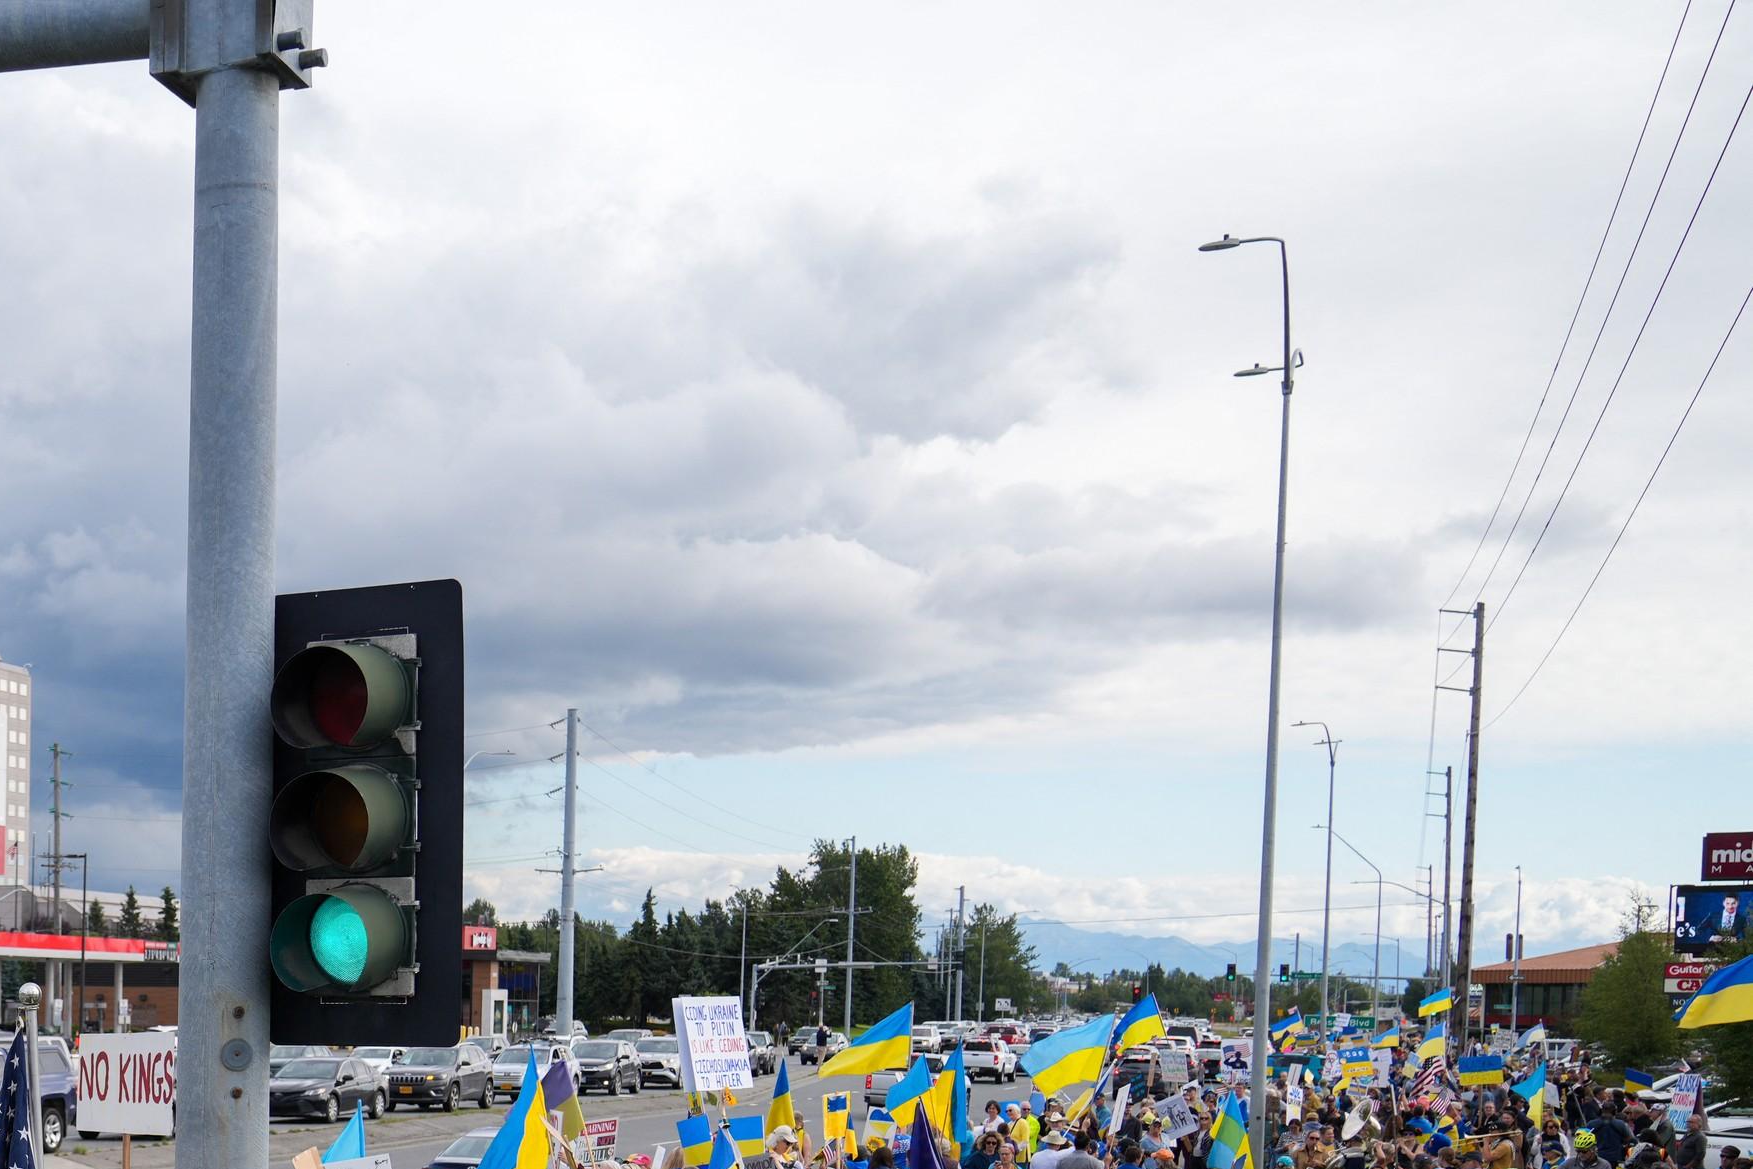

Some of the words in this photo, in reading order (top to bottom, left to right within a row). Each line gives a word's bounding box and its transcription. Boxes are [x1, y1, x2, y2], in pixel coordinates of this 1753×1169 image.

[1669, 965, 1703, 975] Guitar
[685, 1005, 707, 1020] CEDING
[708, 1004, 739, 1020] UKRAINE
[695, 1022, 704, 1036] TO
[712, 1021, 735, 1036] PUTIN
[1349, 1016, 1370, 1027] Blvd
[692, 1040, 698, 1053] IS
[699, 1039, 715, 1053] LIKE
[719, 1037, 745, 1053] CEDING
[695, 1058, 750, 1074] CZECHOSLOVAKIA
[80, 1051, 109, 1101] NO
[118, 1050, 174, 1104] KINGS
[701, 1076, 710, 1088] TO
[717, 1073, 742, 1088] HITLER
[581, 1121, 615, 1135] ARNING
